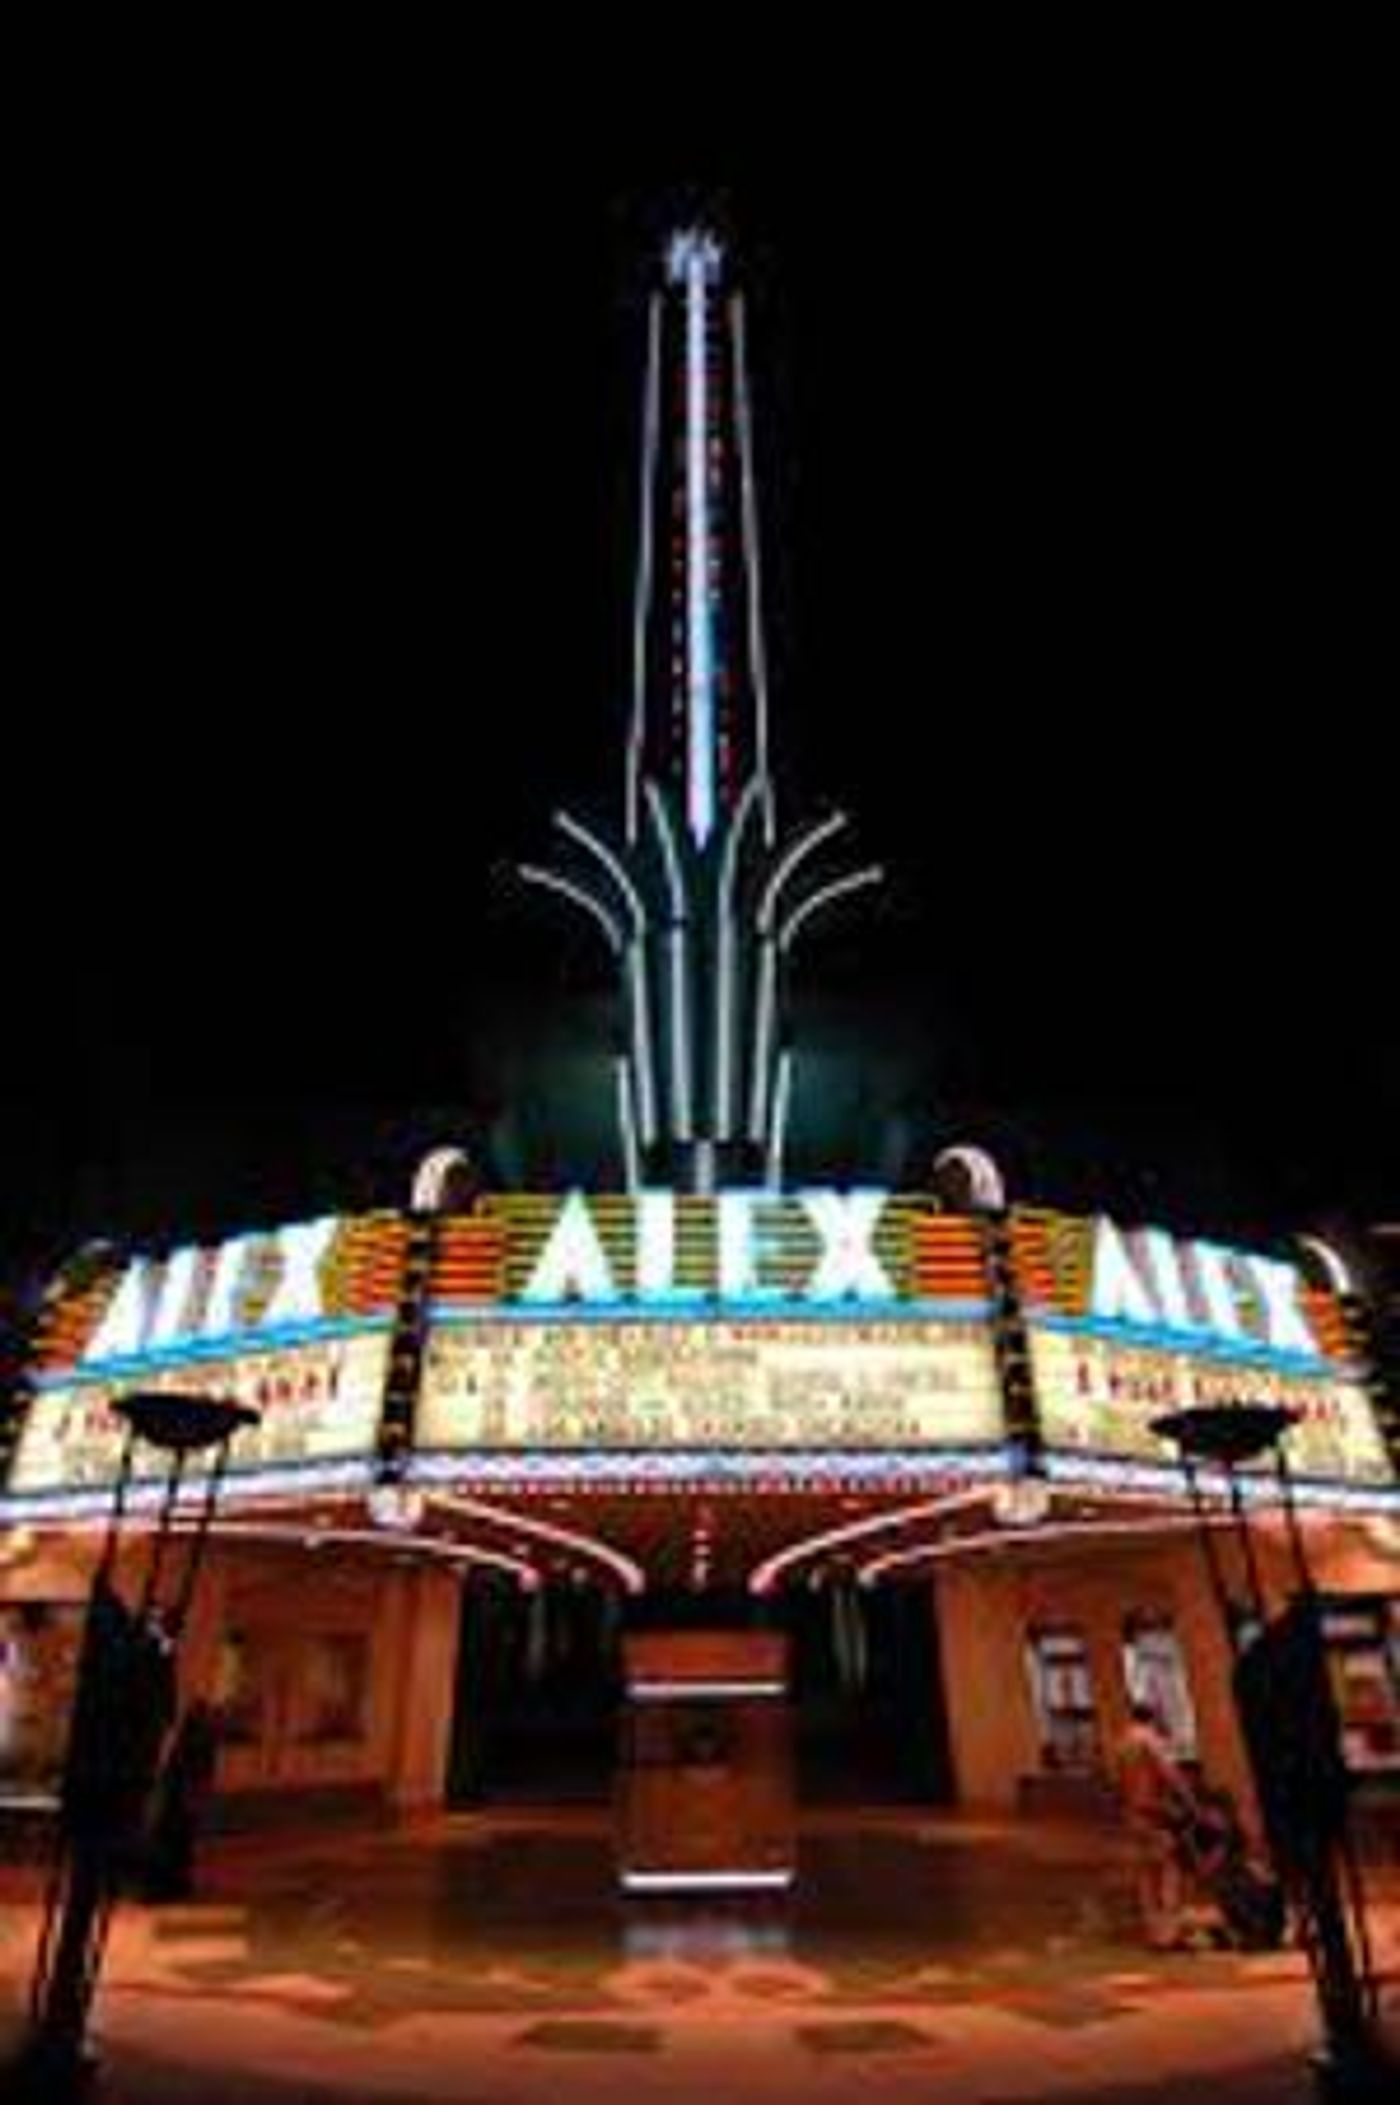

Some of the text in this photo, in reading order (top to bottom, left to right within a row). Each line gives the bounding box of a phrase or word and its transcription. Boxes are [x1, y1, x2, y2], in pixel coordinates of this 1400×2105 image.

[82, 1214, 338, 1362] ALEX
[517, 1186, 898, 1301] ALEX
[1092, 1211, 1323, 1360] ALEX
